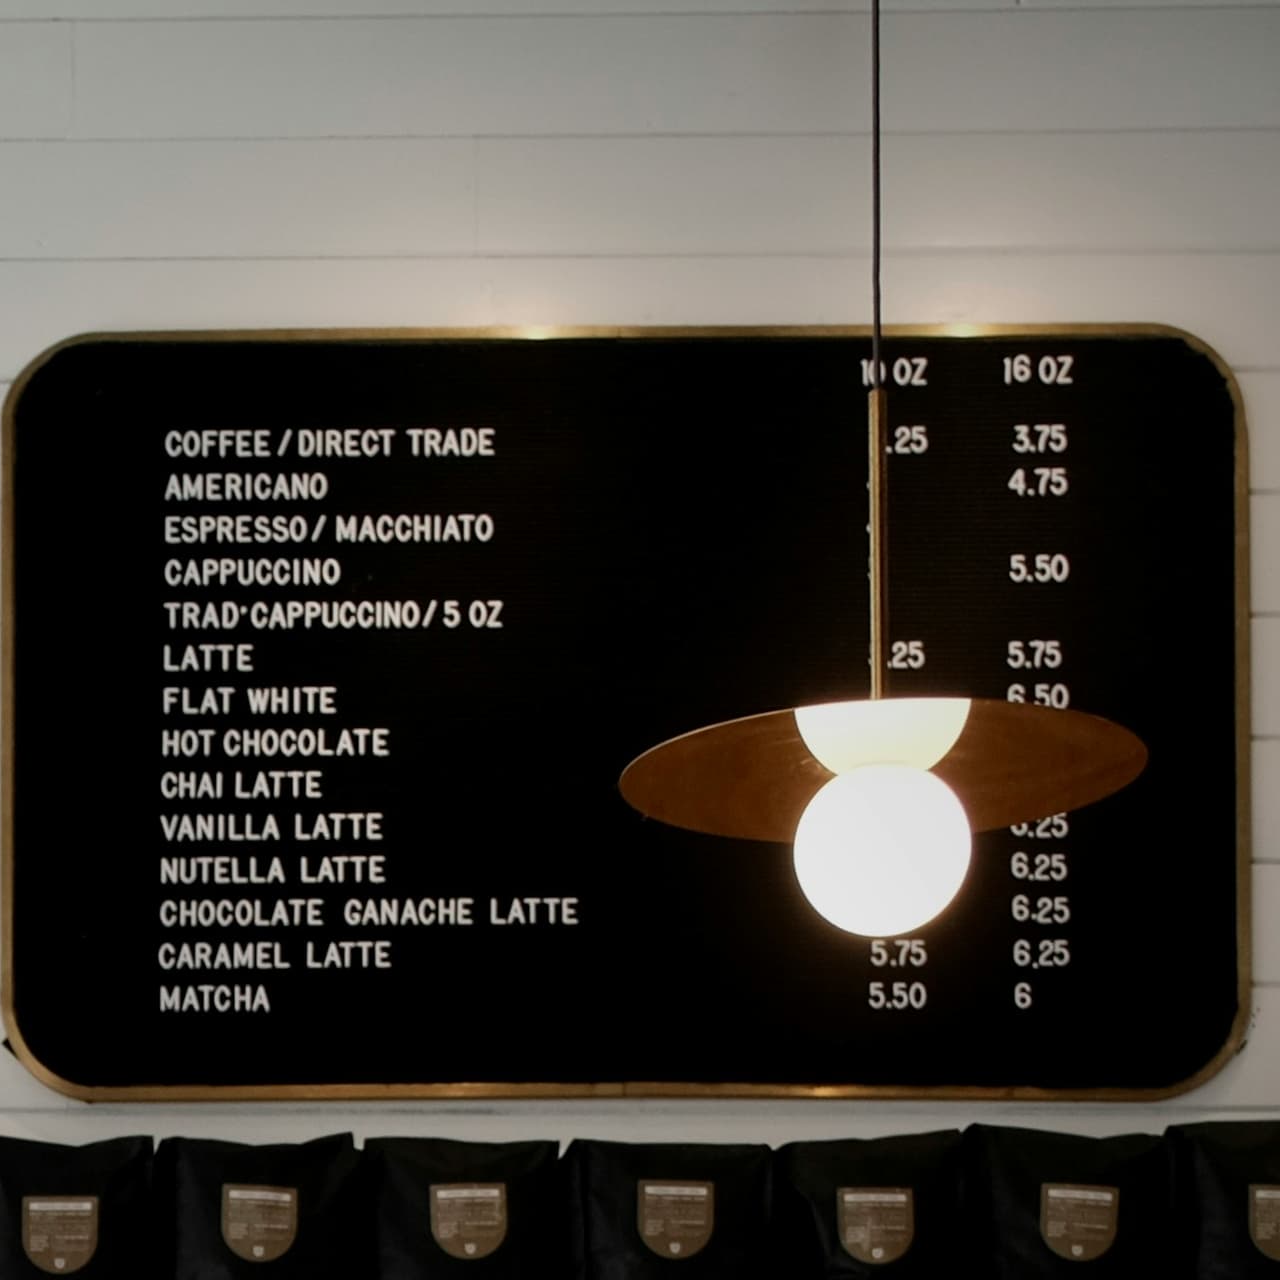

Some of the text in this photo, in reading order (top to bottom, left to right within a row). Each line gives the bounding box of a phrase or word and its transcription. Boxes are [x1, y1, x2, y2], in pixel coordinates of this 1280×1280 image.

[892, 357, 928, 386] OZ
[1003, 354, 1074, 385] 16 OZ
[405, 427, 496, 457] TRADE
[1011, 423, 1069, 454] 3.75
[164, 472, 328, 501] AMERICANO
[1007, 466, 1069, 496] 4.75
[335, 513, 495, 543] MACCHIATO
[164, 556, 341, 587] CAPPUCCINO
[1009, 553, 1071, 583] 5.50
[468, 599, 503, 629] OZ
[163, 643, 254, 672] LATTE
[1006, 639, 1062, 669] 5.75
[163, 686, 337, 715] FLAT WHITE
[162, 728, 390, 758] HOT CHOCOLATE
[160, 770, 323, 799] CHAI LATTE
[160, 812, 383, 842] VANILLA LATTE
[160, 855, 386, 884] NUTELLA LATTE
[1011, 851, 1069, 881] 6.25
[159, 897, 579, 927] CHOCOLATE GANACHE LATTE
[1011, 894, 1071, 924] 6.25
[158, 940, 392, 970] CARAMEL LATTE
[869, 940, 928, 968] 5.75
[1013, 939, 1071, 969] 6.25
[159, 984, 270, 1012] MATCHA
[868, 981, 927, 1010] 5.50
[1014, 982, 1033, 1009] 6
